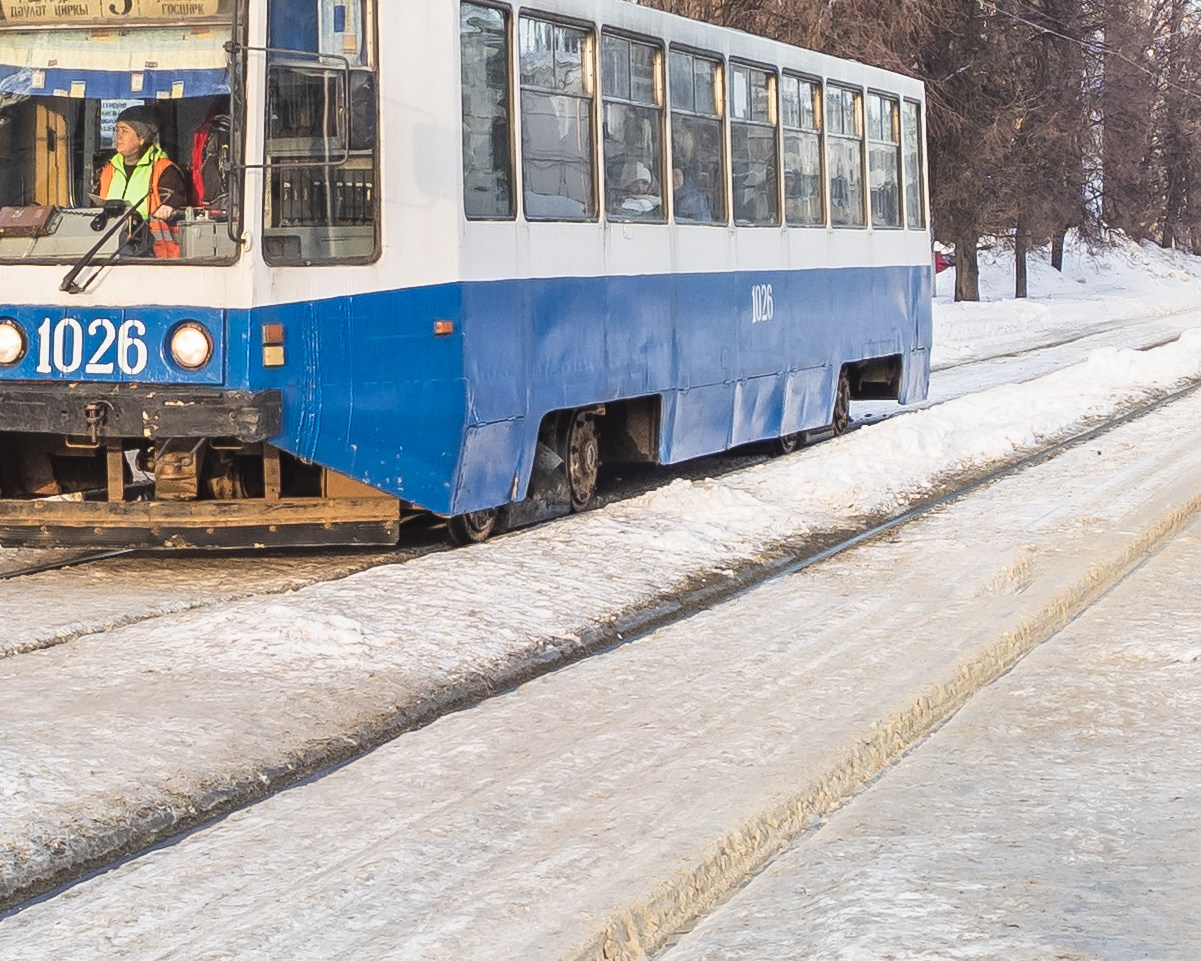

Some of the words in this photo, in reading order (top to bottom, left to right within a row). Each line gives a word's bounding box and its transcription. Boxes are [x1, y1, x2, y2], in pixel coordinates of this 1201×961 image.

[161, 3, 205, 16] ГОСЦИРК
[752, 283, 774, 324] 1026
[36, 317, 148, 375] 1026
